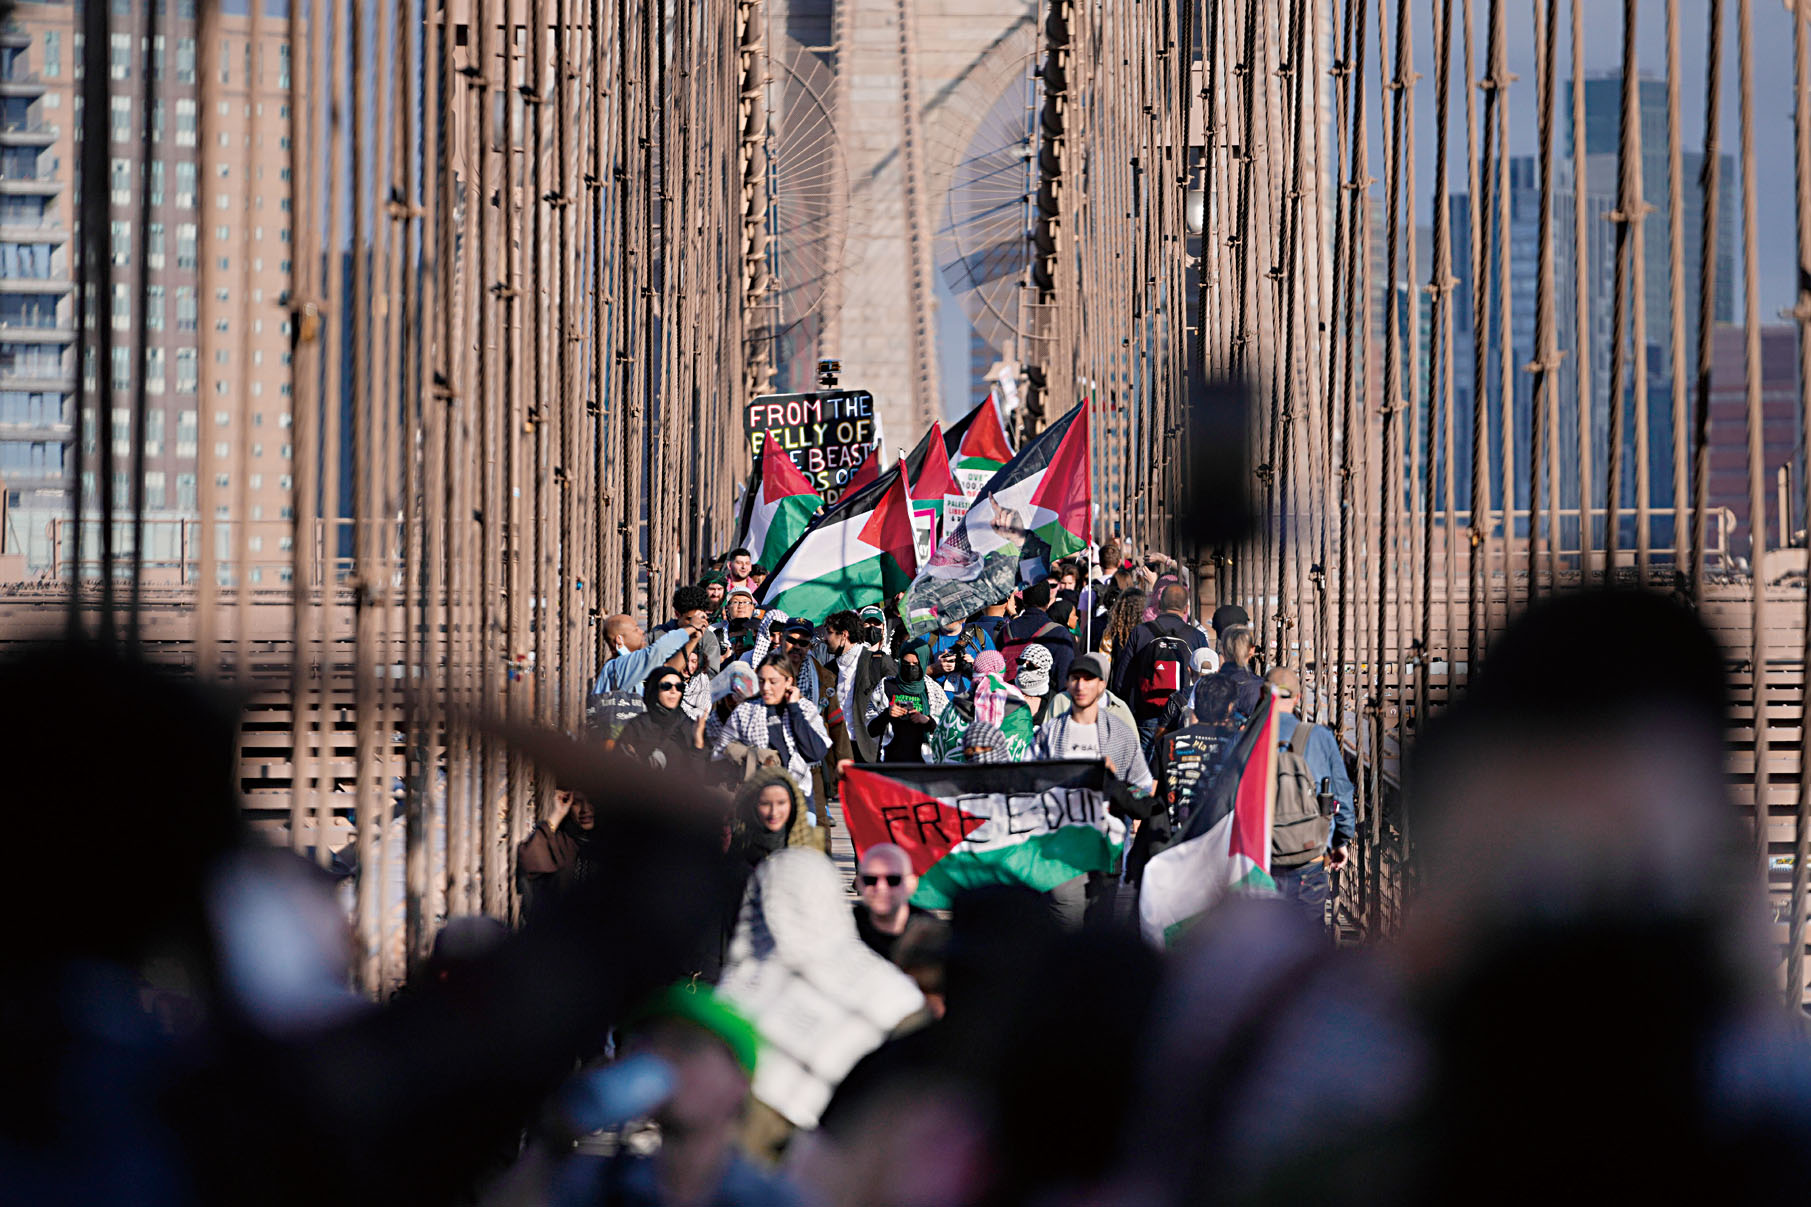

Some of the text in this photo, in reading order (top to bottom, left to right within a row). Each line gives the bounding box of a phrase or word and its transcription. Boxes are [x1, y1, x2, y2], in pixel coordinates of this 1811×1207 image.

[750, 395, 872, 428] FROM THE
[836, 420, 871, 444] OF
[808, 442, 872, 473] BEAST
